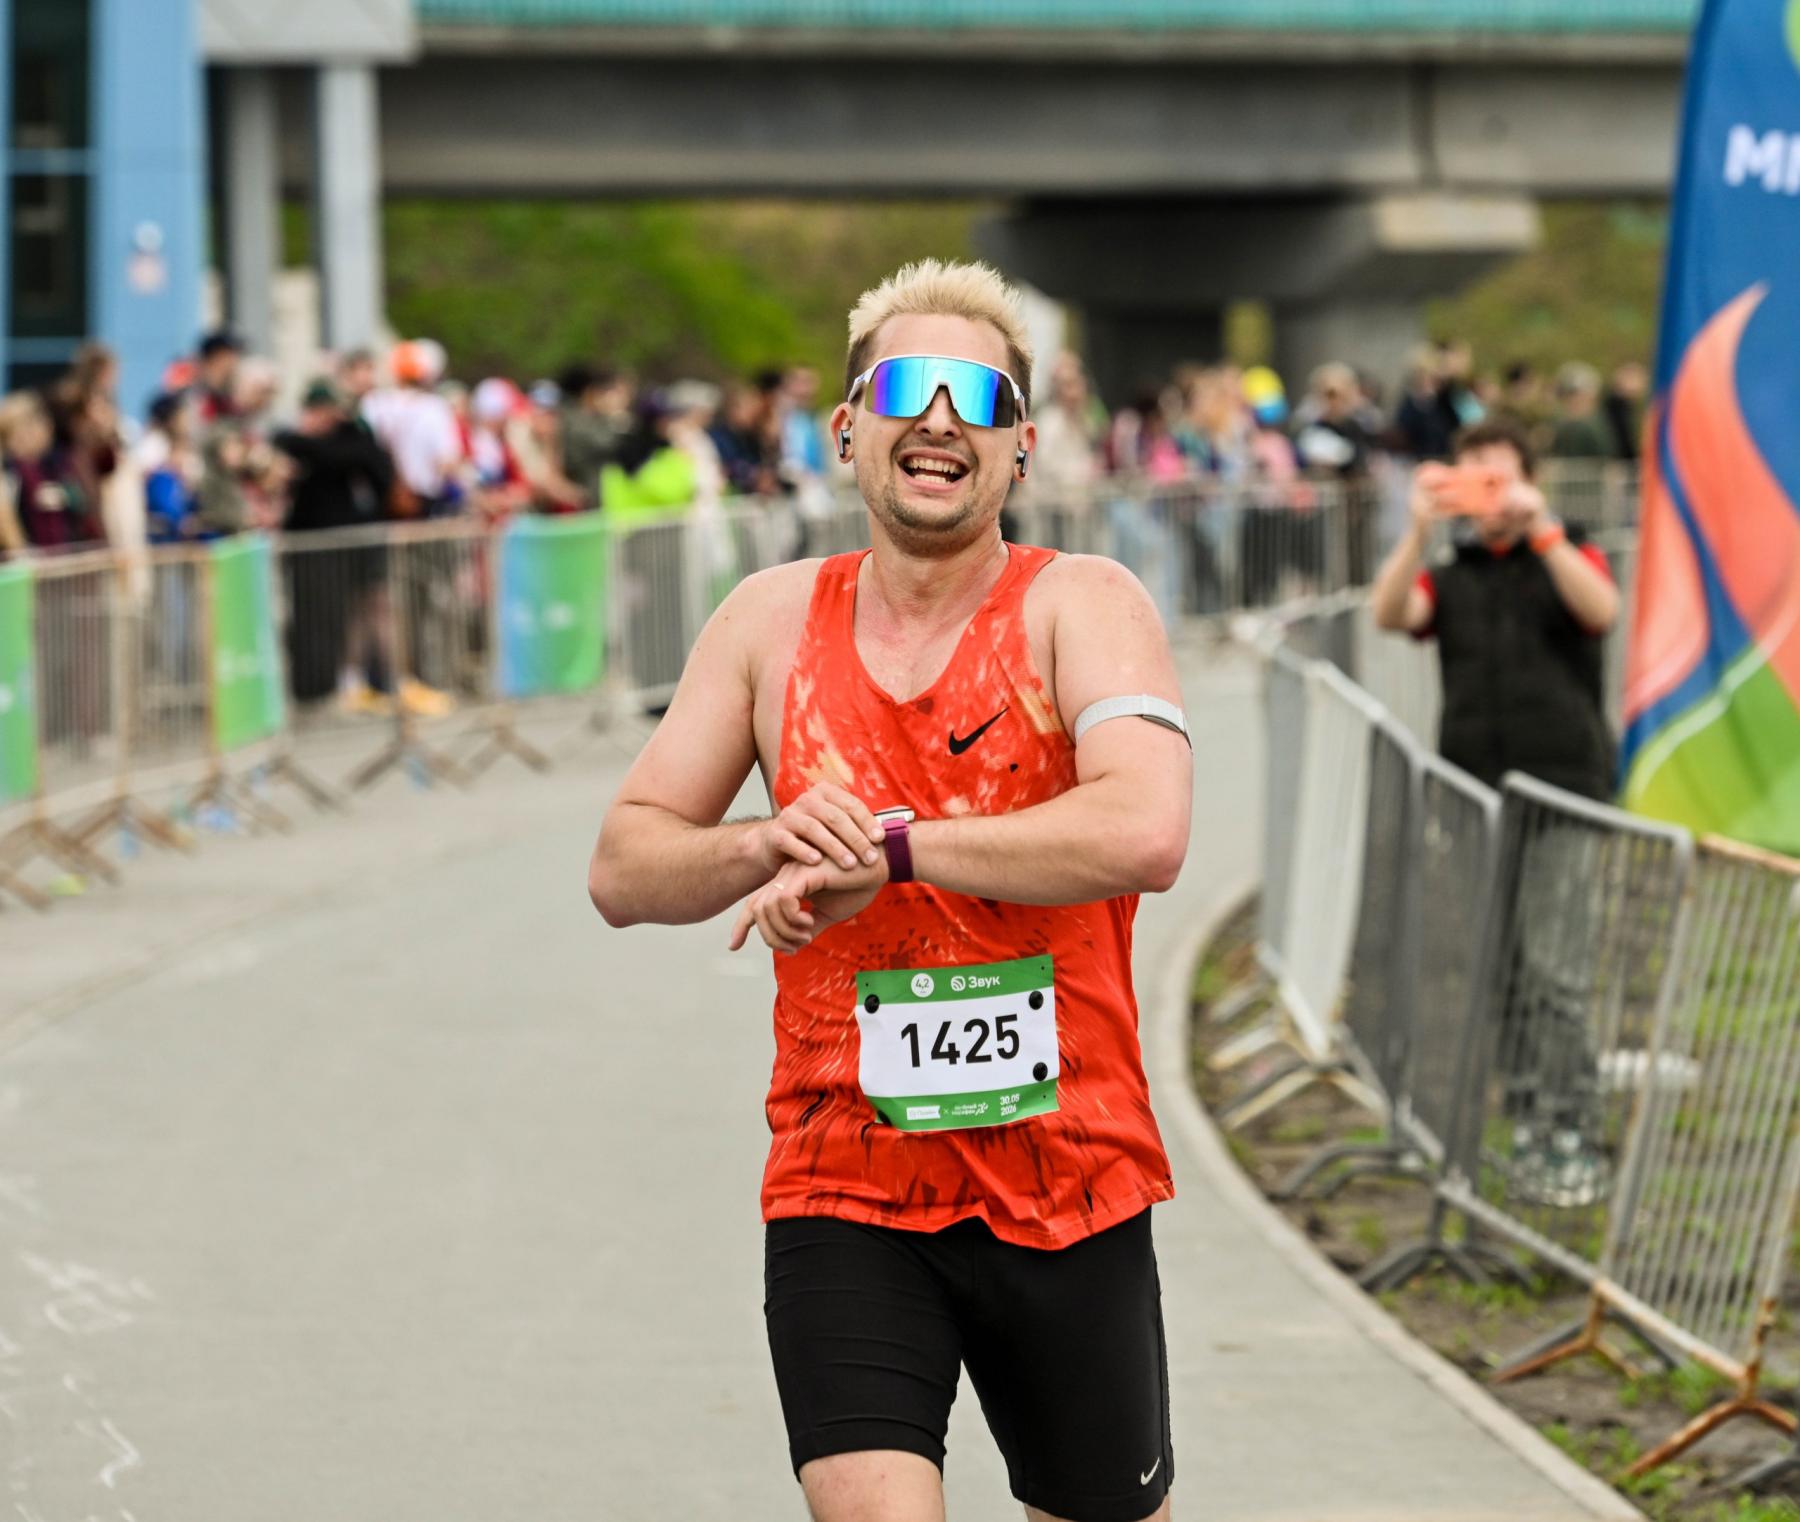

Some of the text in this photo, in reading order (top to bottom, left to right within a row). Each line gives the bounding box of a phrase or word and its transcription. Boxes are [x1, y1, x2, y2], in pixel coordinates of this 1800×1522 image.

[968, 976, 1001, 989] Звук
[901, 1014, 1020, 1068] 1425
[1000, 1093, 1020, 1106] 30.05
